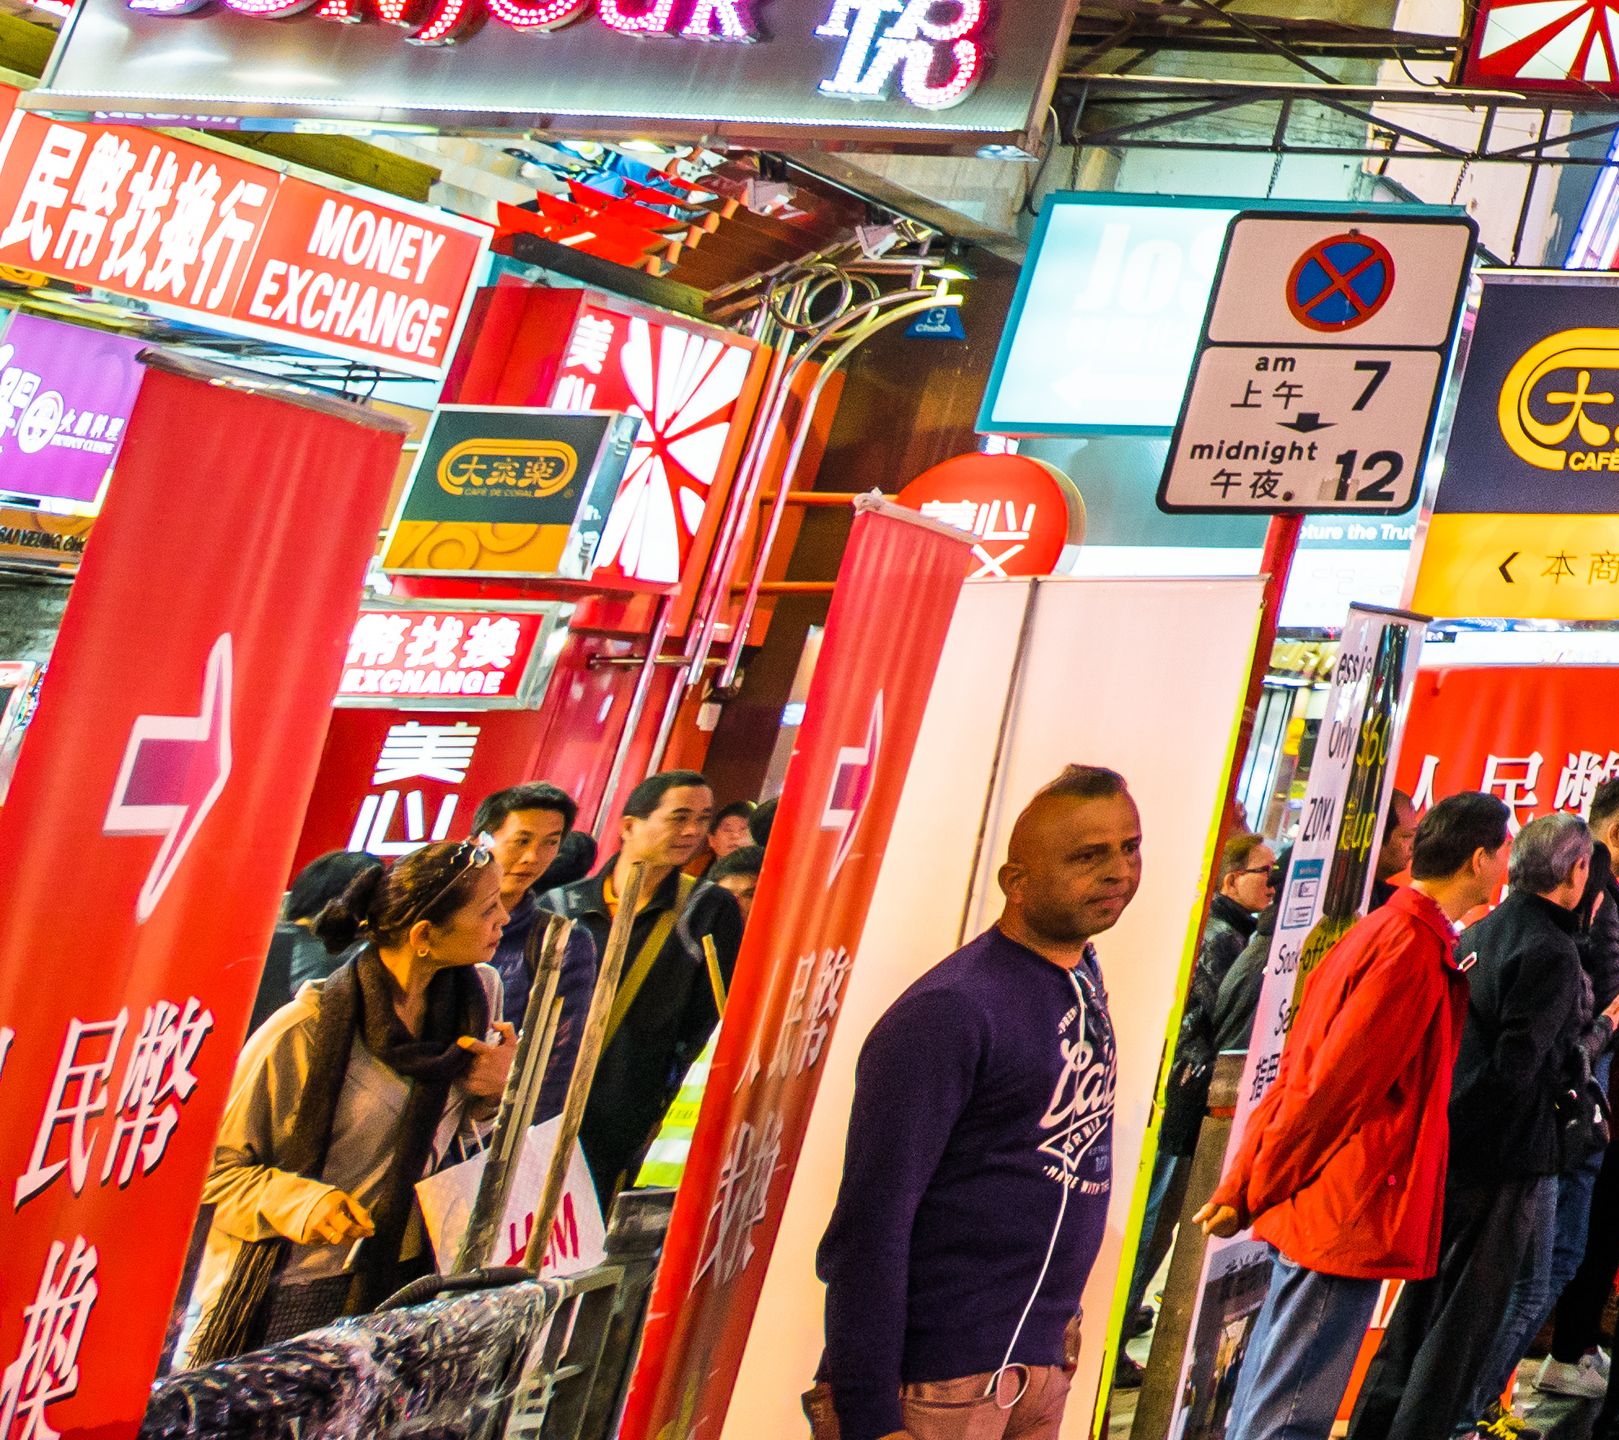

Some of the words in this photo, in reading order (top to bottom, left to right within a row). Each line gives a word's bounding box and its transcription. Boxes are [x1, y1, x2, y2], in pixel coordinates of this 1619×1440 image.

[309, 200, 446, 286] MONEY
[250, 260, 450, 359] EXCHANGE
[1255, 355, 1297, 374] am
[1231, 382, 1304, 411] 上午
[1353, 361, 1390, 412] 7
[1189, 439, 1318, 466] midnight
[1210, 471, 1280, 499] 午夜
[347, 720, 474, 858] 美心
